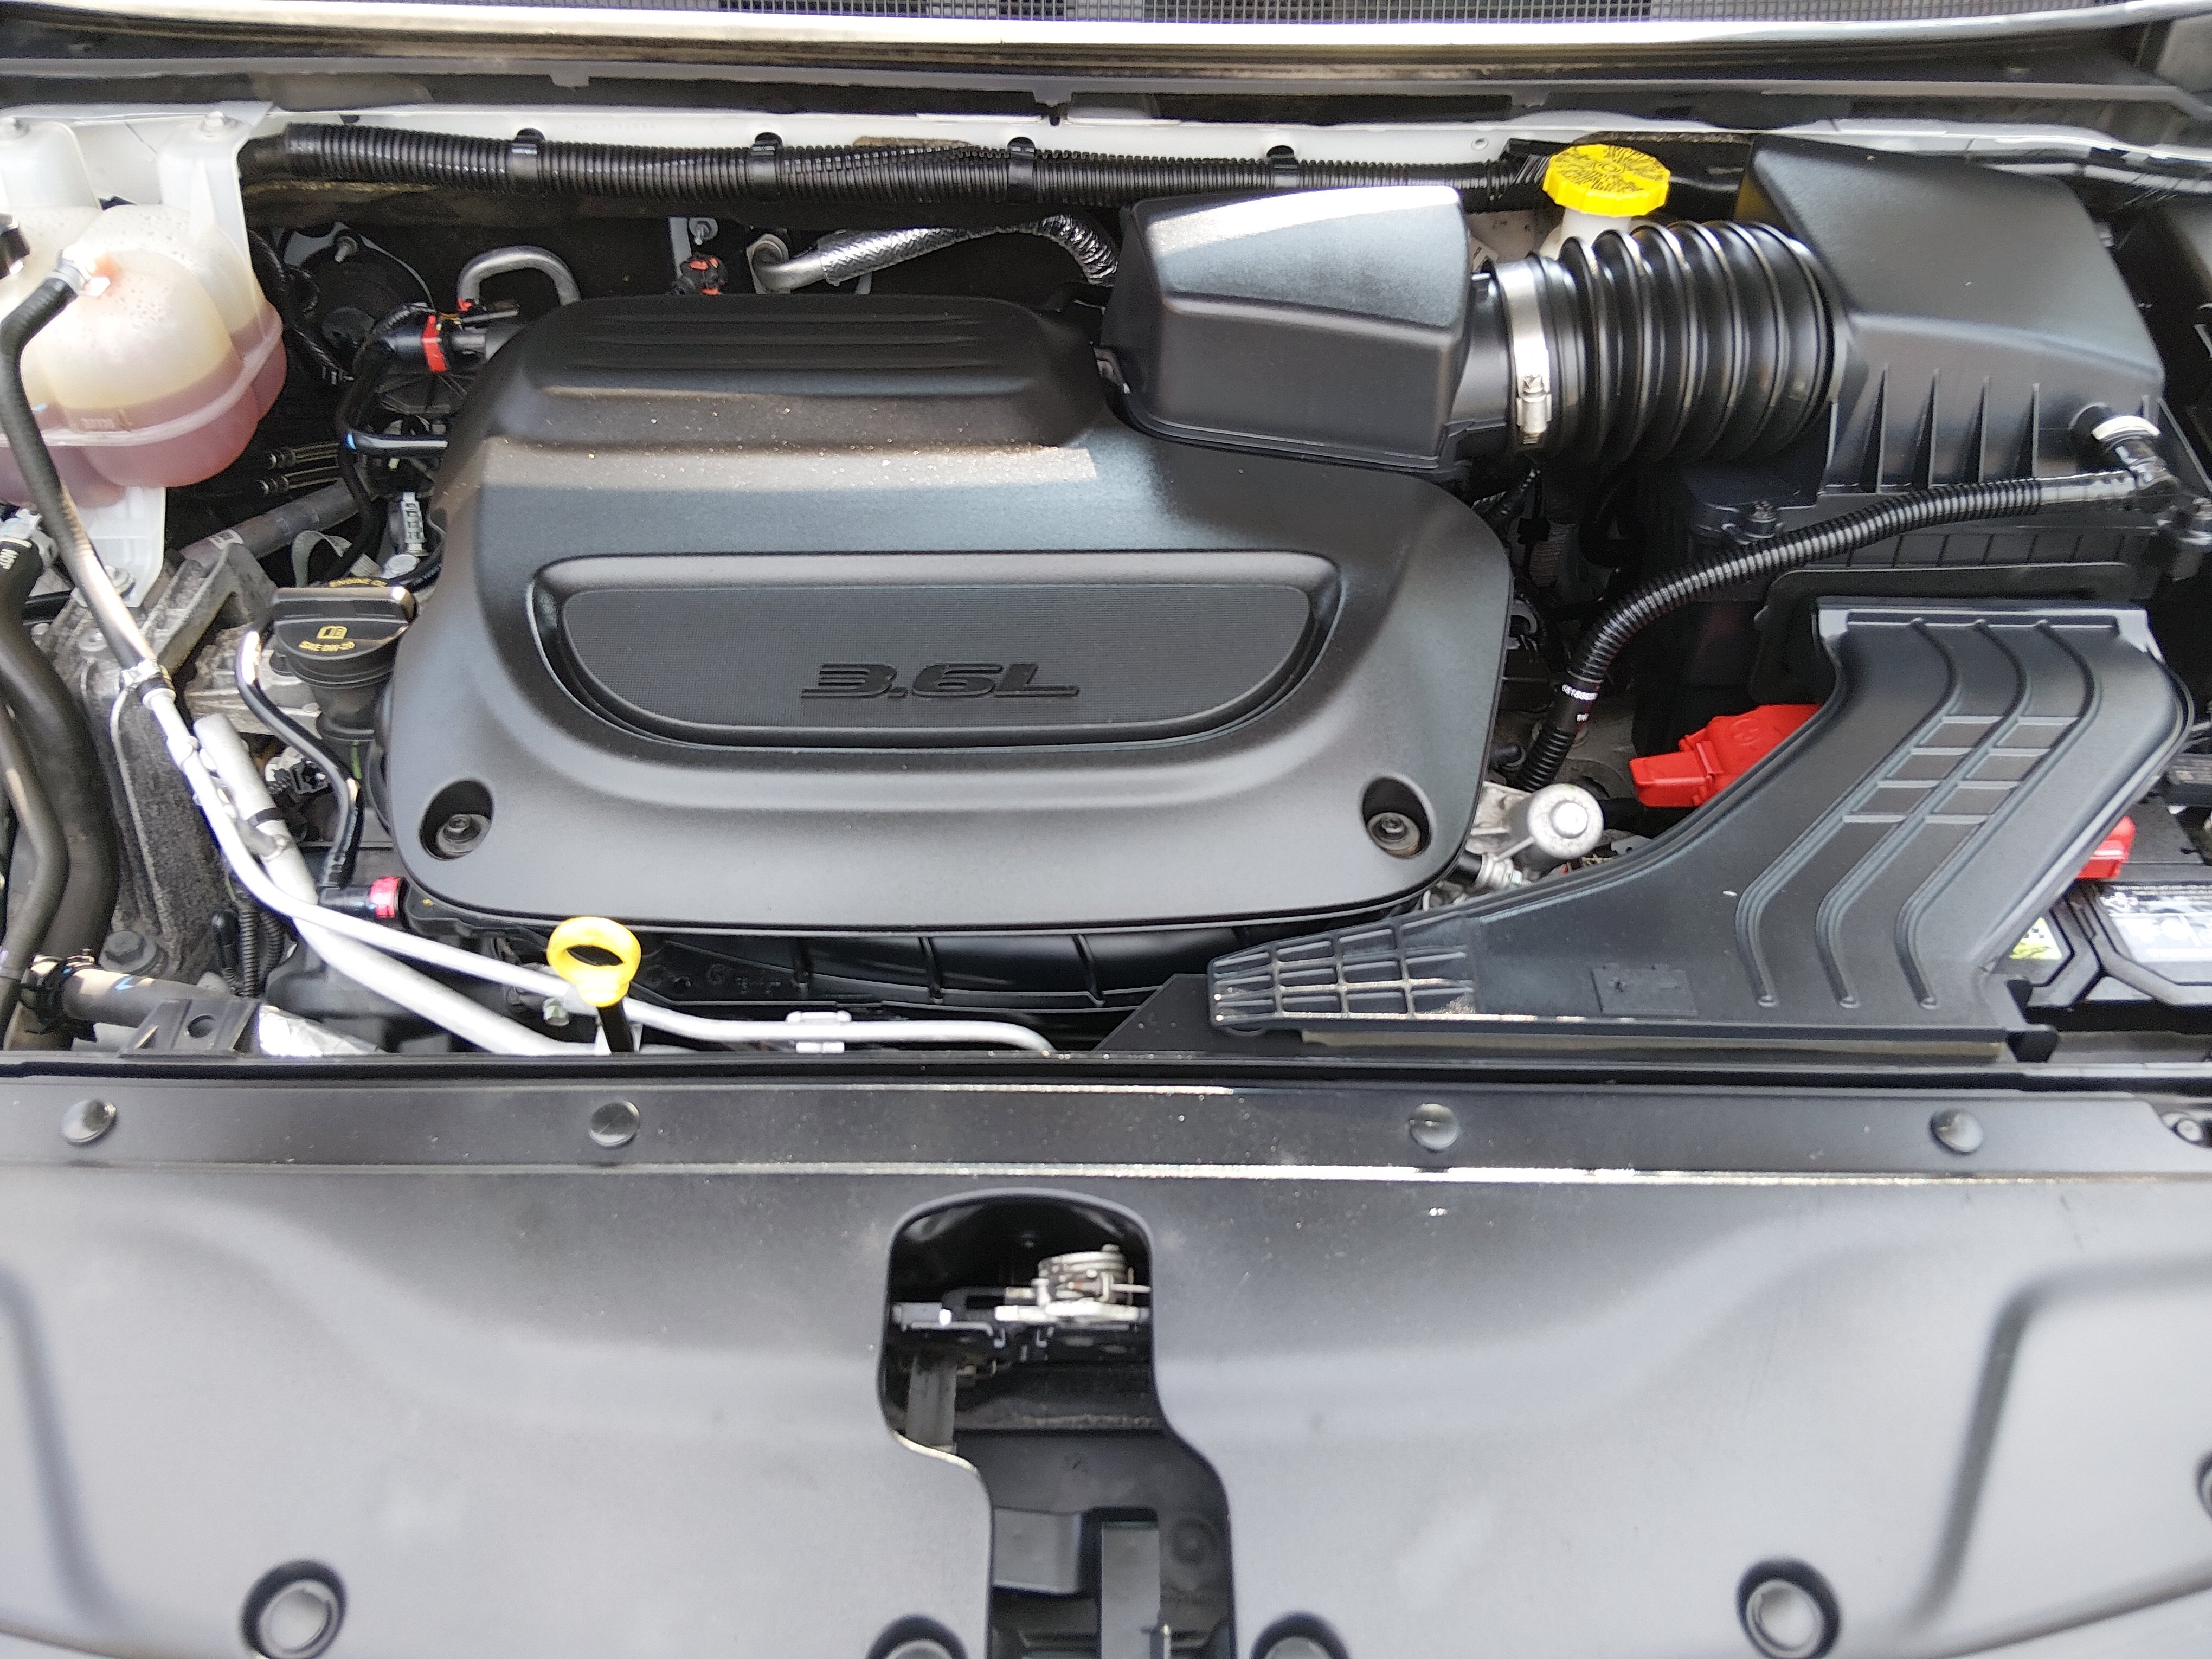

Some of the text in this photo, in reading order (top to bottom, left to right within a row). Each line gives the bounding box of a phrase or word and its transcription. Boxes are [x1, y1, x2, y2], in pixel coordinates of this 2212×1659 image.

[329, 578, 370, 587] ENGINE
[299, 641, 323, 651] SAE
[800, 662, 1081, 699] 3.6L
